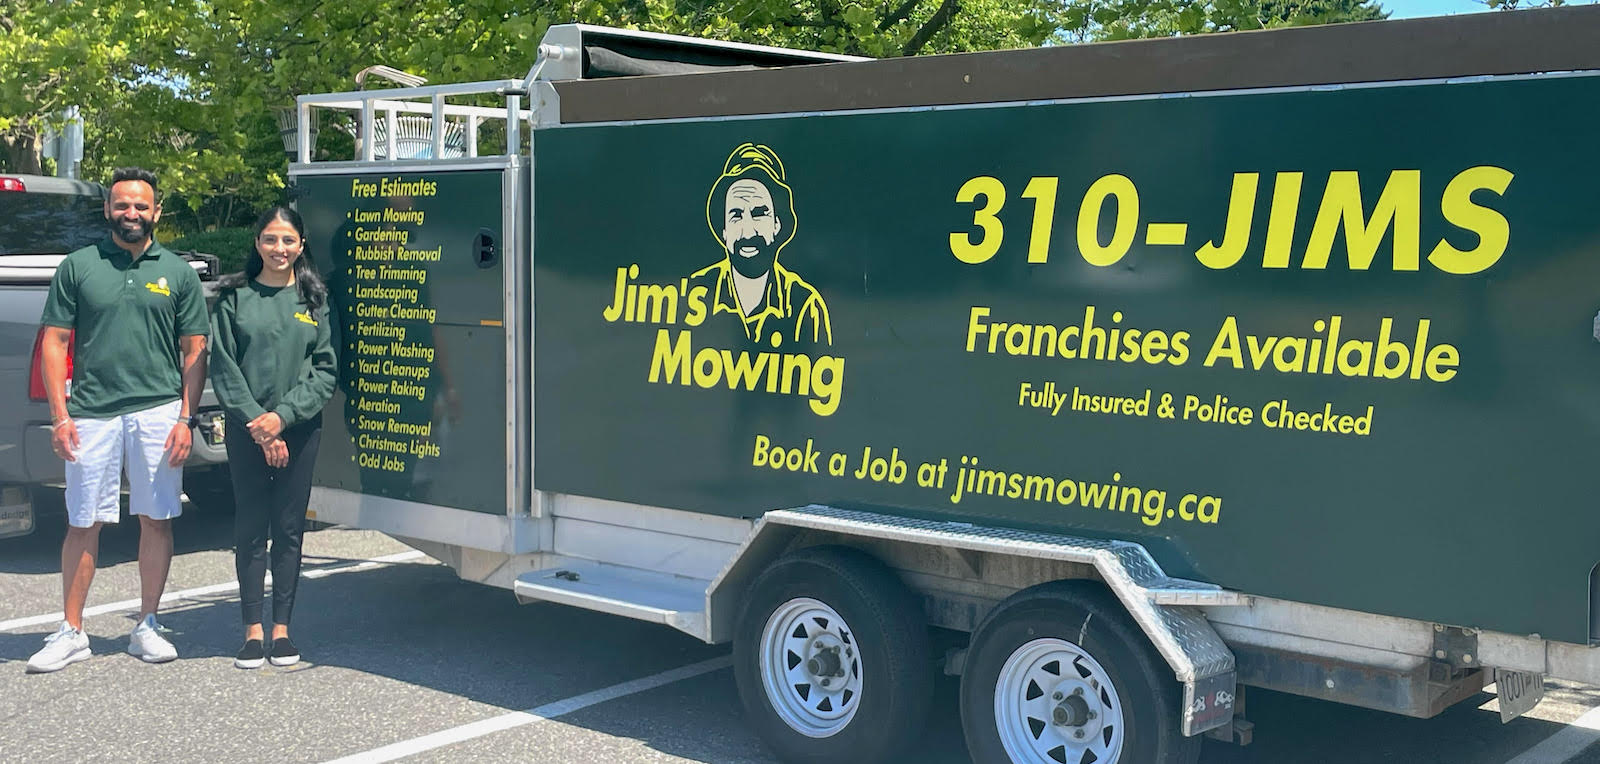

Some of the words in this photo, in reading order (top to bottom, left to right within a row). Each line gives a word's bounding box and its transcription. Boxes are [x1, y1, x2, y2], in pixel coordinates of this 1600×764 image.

[352, 179, 377, 197] Free
[380, 177, 437, 197] Estimates
[355, 209, 380, 222] Lawn
[383, 208, 425, 225] Mowing
[950, 166, 1513, 274] 310-JIMS
[355, 227, 408, 245] Gardening
[355, 245, 395, 260] Rubbish
[397, 245, 441, 261] Removal
[356, 265, 376, 280] Tree
[379, 264, 427, 284] Trimming
[356, 284, 418, 303] Landscaping
[603, 264, 707, 327] Jim's
[356, 303, 388, 318] Gutter
[390, 304, 436, 323] Cleaning
[358, 322, 406, 341] Fertilizing
[358, 341, 387, 355] Power
[391, 342, 434, 362] Washing
[966, 306, 1190, 367] Franchises
[1204, 316, 1459, 382] Available
[358, 359, 380, 374] Yard
[383, 360, 430, 380] Cleanups
[648, 329, 844, 416] Mowing
[358, 378, 387, 393] Power
[391, 380, 425, 400] Raking
[358, 396, 401, 414] Aeration
[1019, 382, 1067, 416] Fully
[1072, 387, 1151, 417] Insured
[1157, 393, 1174, 419] &
[1183, 394, 1253, 425] Police
[1261, 400, 1373, 435] Checked
[358, 416, 385, 430] Snow
[388, 417, 432, 437] Removal
[359, 434, 407, 453] Christmas
[409, 440, 440, 459] Lights
[359, 452, 380, 468] Odd
[382, 455, 404, 471] Jobs
[752, 435, 819, 473] Book
[829, 453, 846, 476] a
[854, 447, 906, 484] Job
[917, 459, 948, 488] at
[950, 456, 1221, 526] jimsmowing.ca
